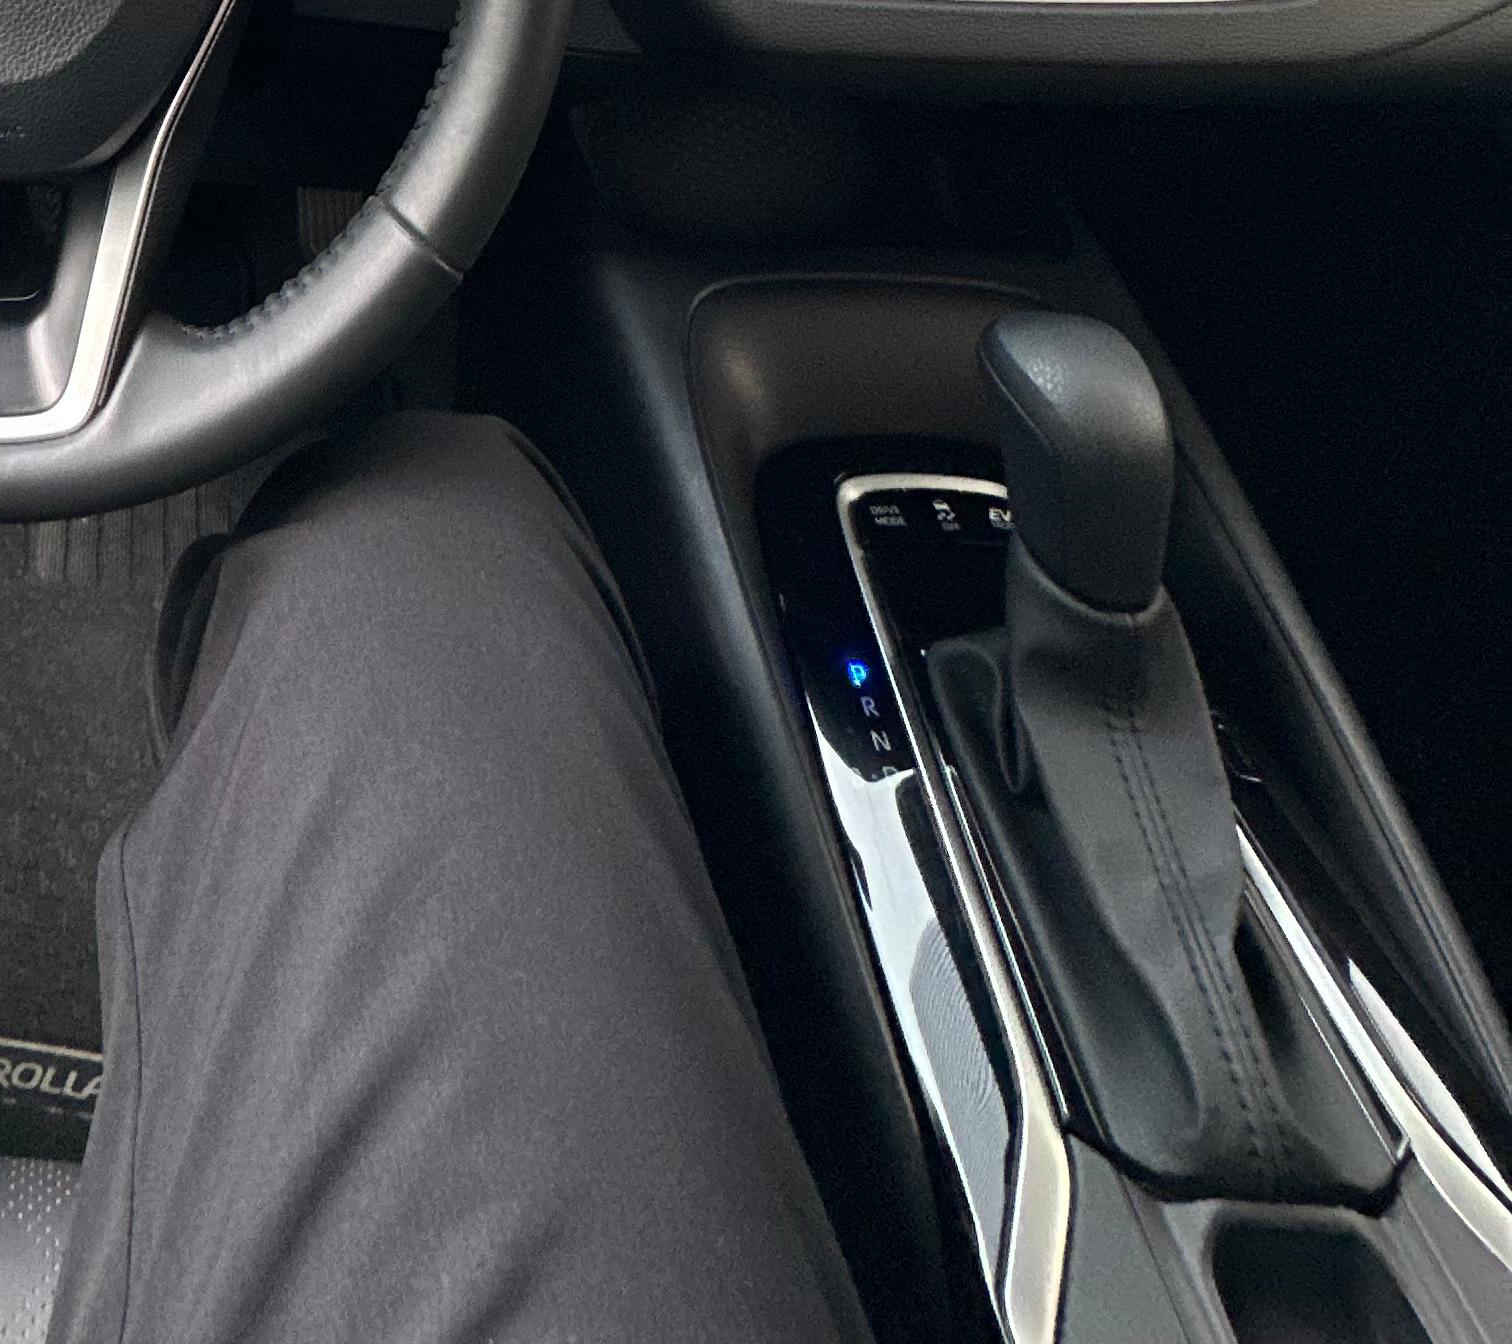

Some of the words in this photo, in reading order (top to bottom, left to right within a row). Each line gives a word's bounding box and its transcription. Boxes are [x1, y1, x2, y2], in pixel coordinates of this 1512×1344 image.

[989, 506, 1012, 522] EV
[847, 663, 868, 687] P
[860, 696, 880, 717] R
[870, 730, 892, 751] N
